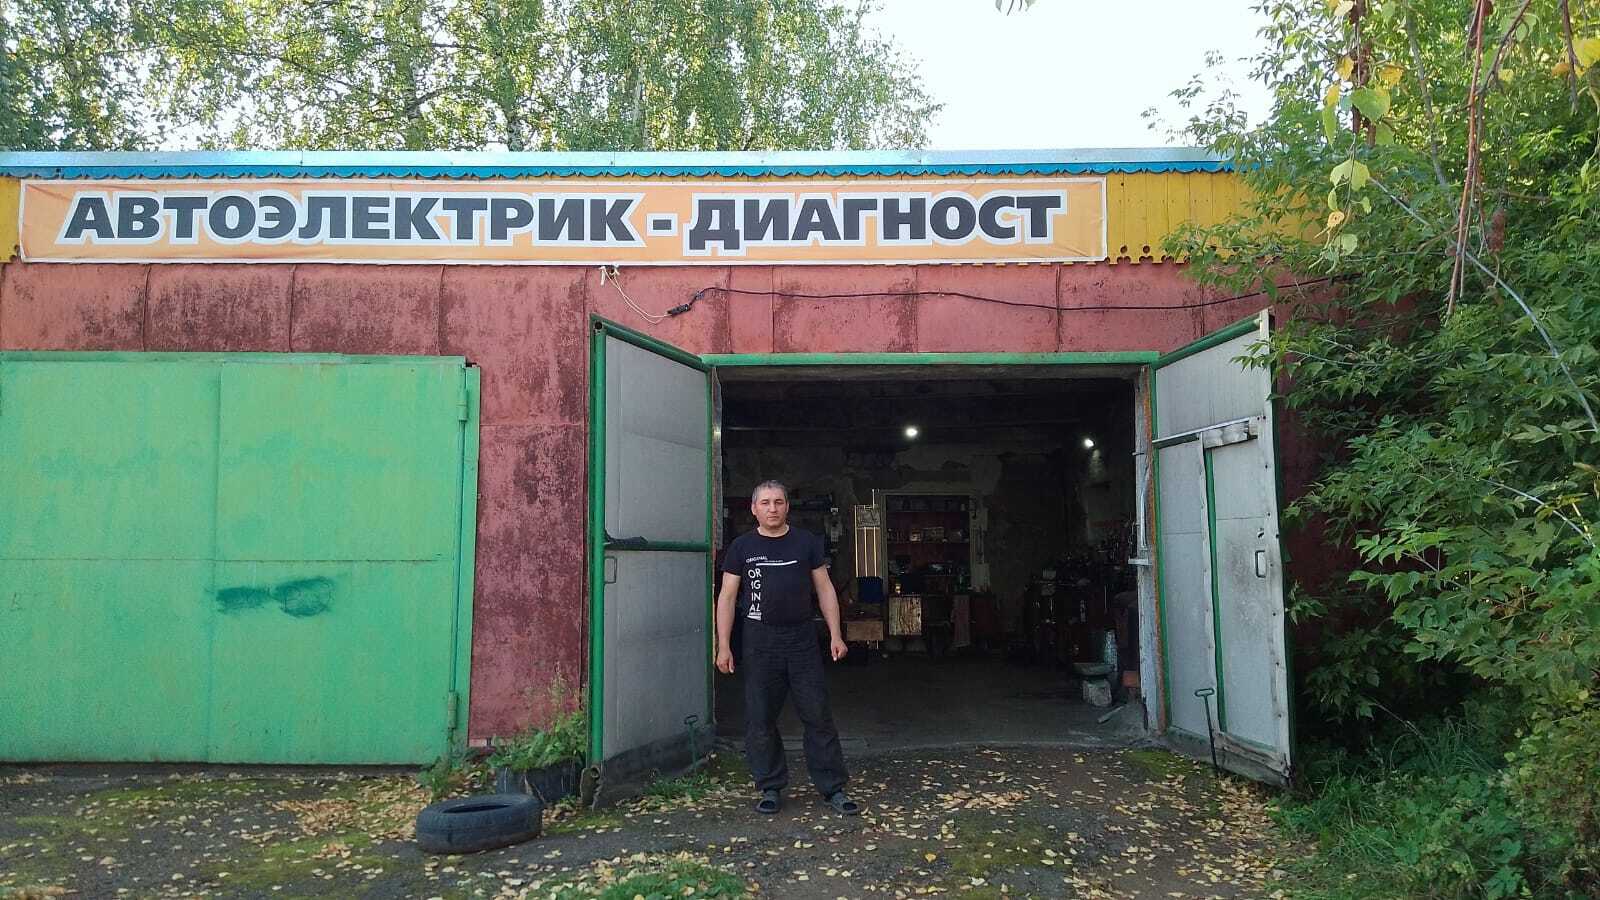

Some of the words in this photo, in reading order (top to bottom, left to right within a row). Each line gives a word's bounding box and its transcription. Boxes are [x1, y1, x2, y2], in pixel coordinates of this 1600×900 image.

[64, 195, 636, 243] АВТОЭЛЕКТРИК
[689, 195, 1062, 250] ДИАГНОСТ
[748, 568, 762, 578] OR
[751, 592, 761, 601] IN
[749, 603, 761, 612] AL
